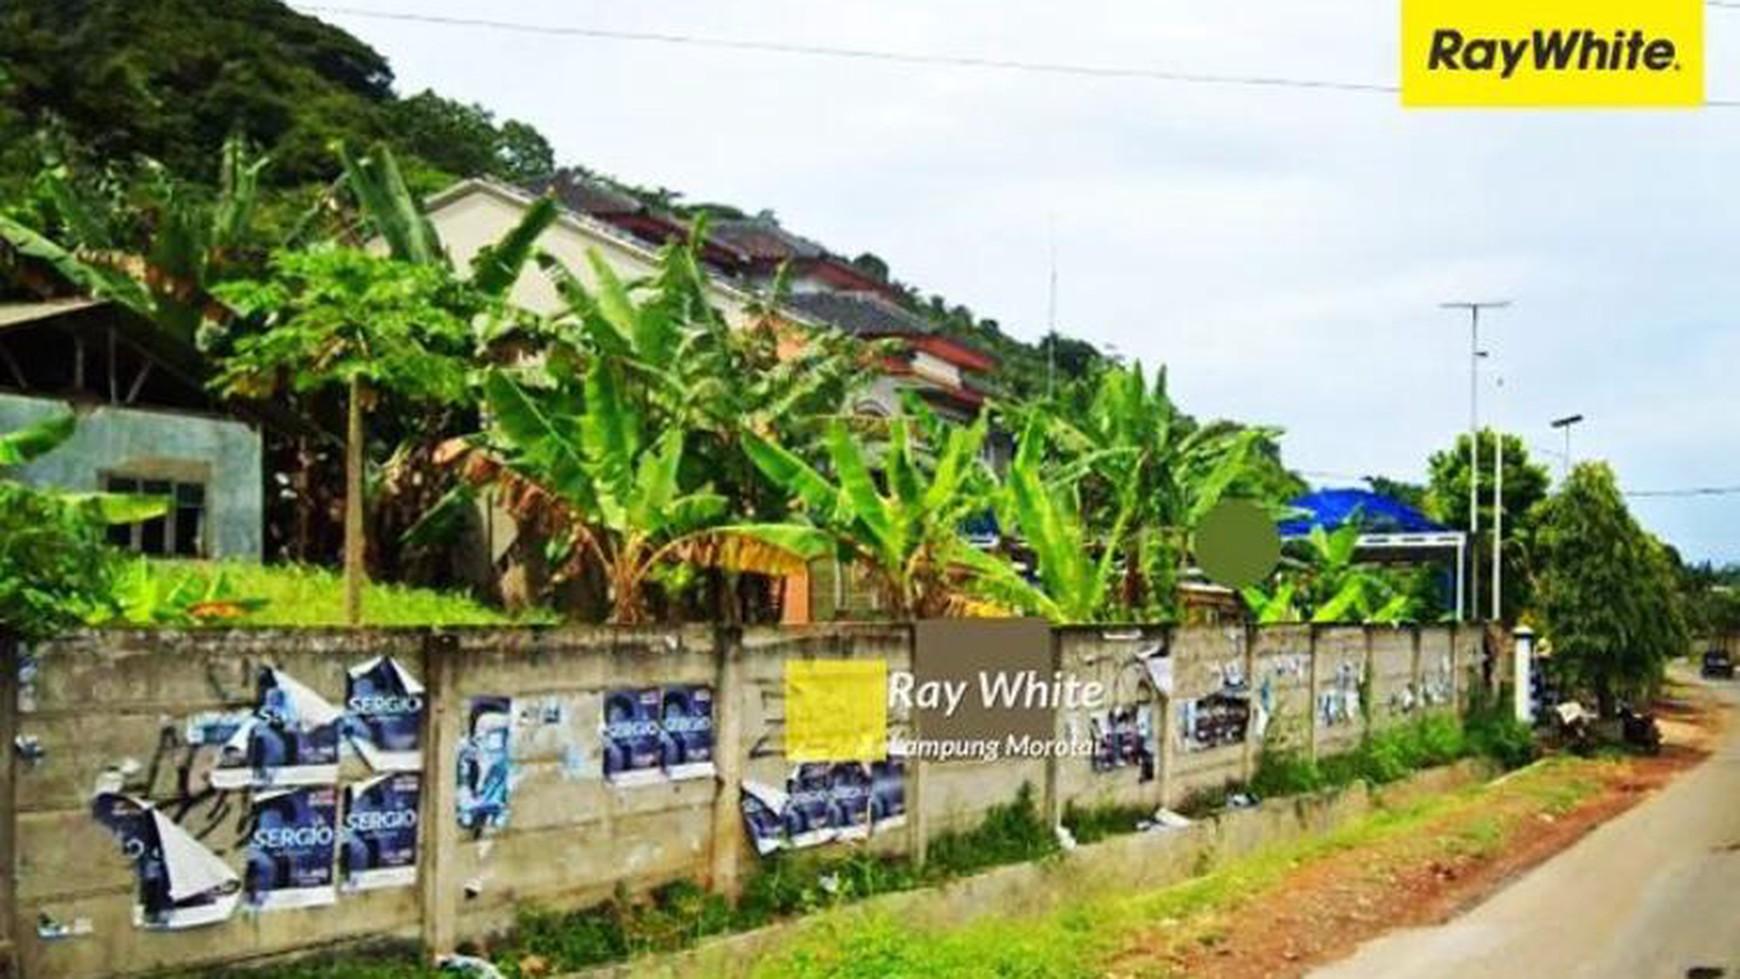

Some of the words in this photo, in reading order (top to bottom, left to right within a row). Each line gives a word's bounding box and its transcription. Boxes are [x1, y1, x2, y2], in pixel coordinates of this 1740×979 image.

[350, 696, 423, 713] SERGIO
[346, 809, 417, 831] SERGIO
[254, 826, 333, 848] SERGIO
